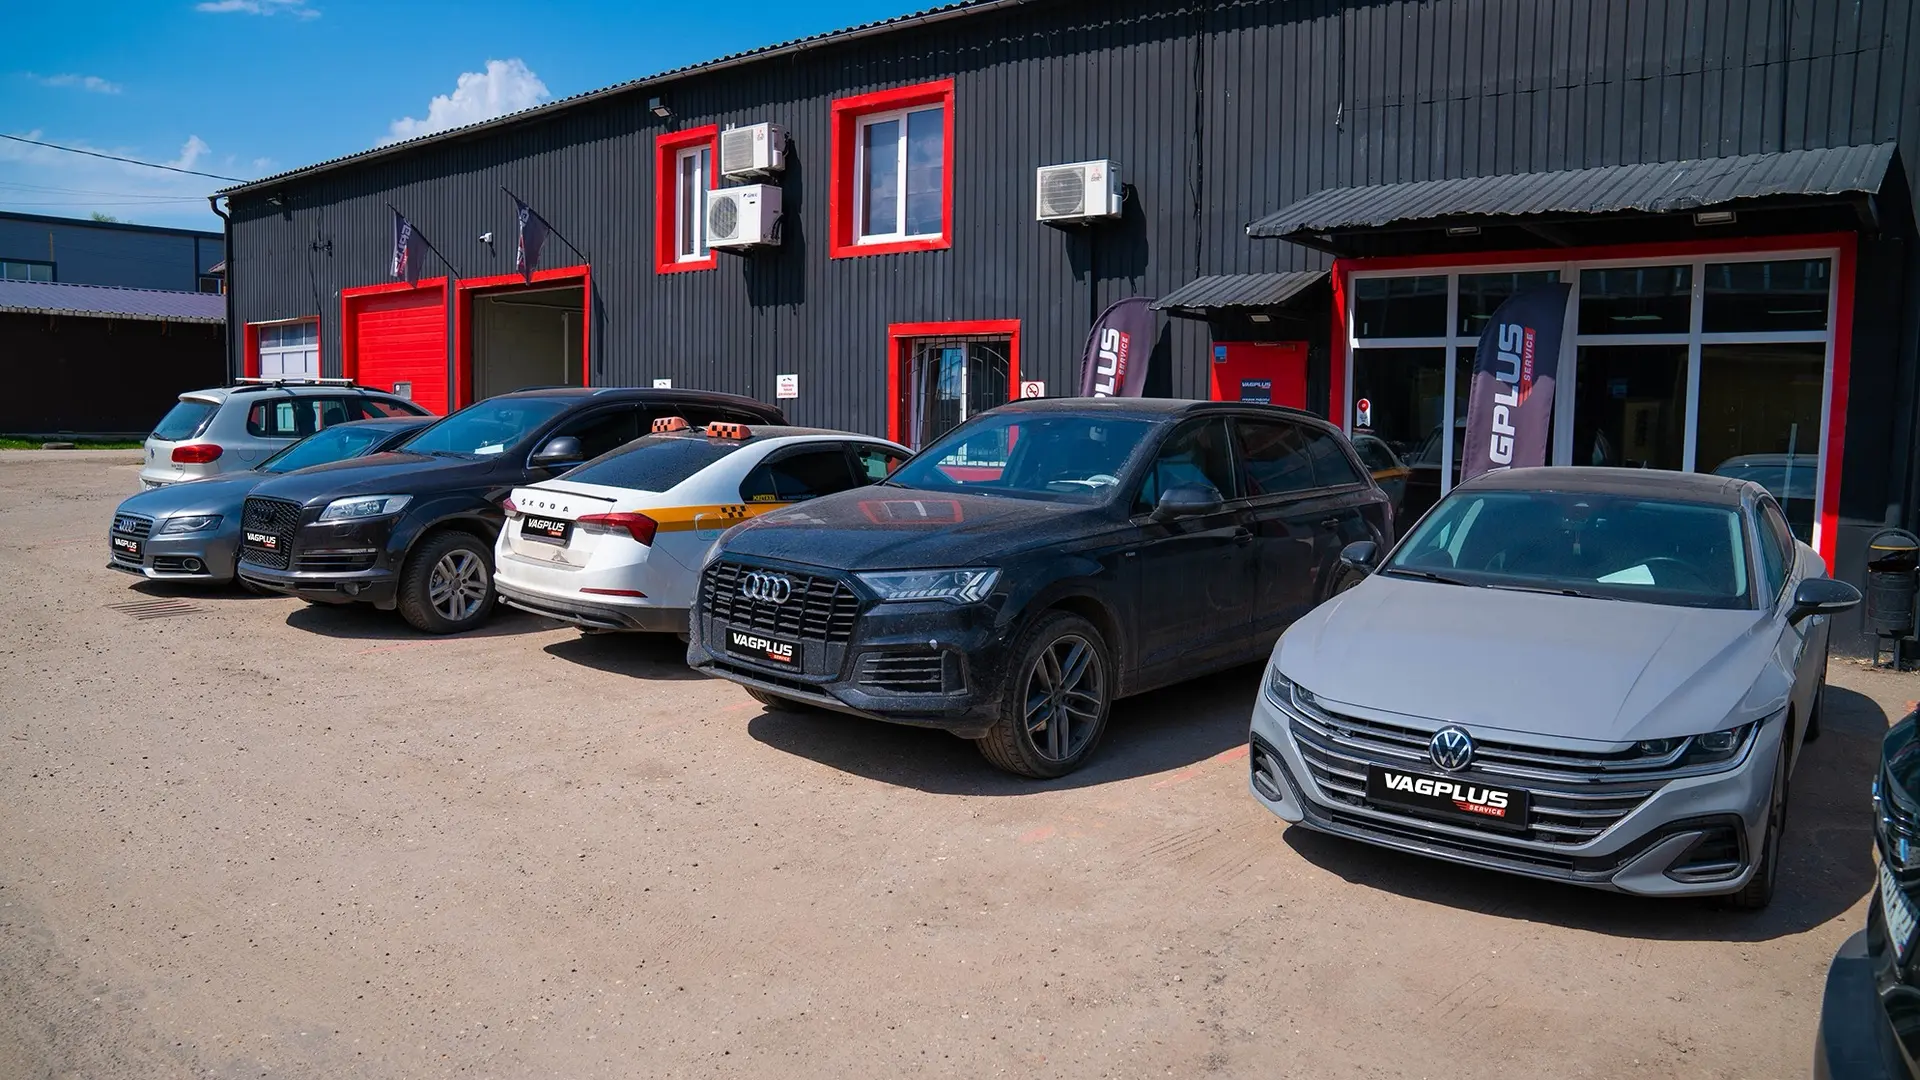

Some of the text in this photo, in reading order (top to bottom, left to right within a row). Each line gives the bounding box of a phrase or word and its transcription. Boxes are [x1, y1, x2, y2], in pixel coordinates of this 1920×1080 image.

[1094, 328, 1120, 398] LUS
[1118, 336, 1128, 375] SERVICE
[1524, 331, 1534, 381] SERVICE
[1487, 323, 1523, 472] GPLUS
[246, 532, 276, 544] VAGPLUS
[527, 518, 565, 532] VAGPLUS
[114, 537, 137, 549] VAGPLUS
[733, 632, 793, 657] VAGPLUS
[1384, 772, 1509, 808] VAGPLUS
[1469, 804, 1502, 816] SERVICE
